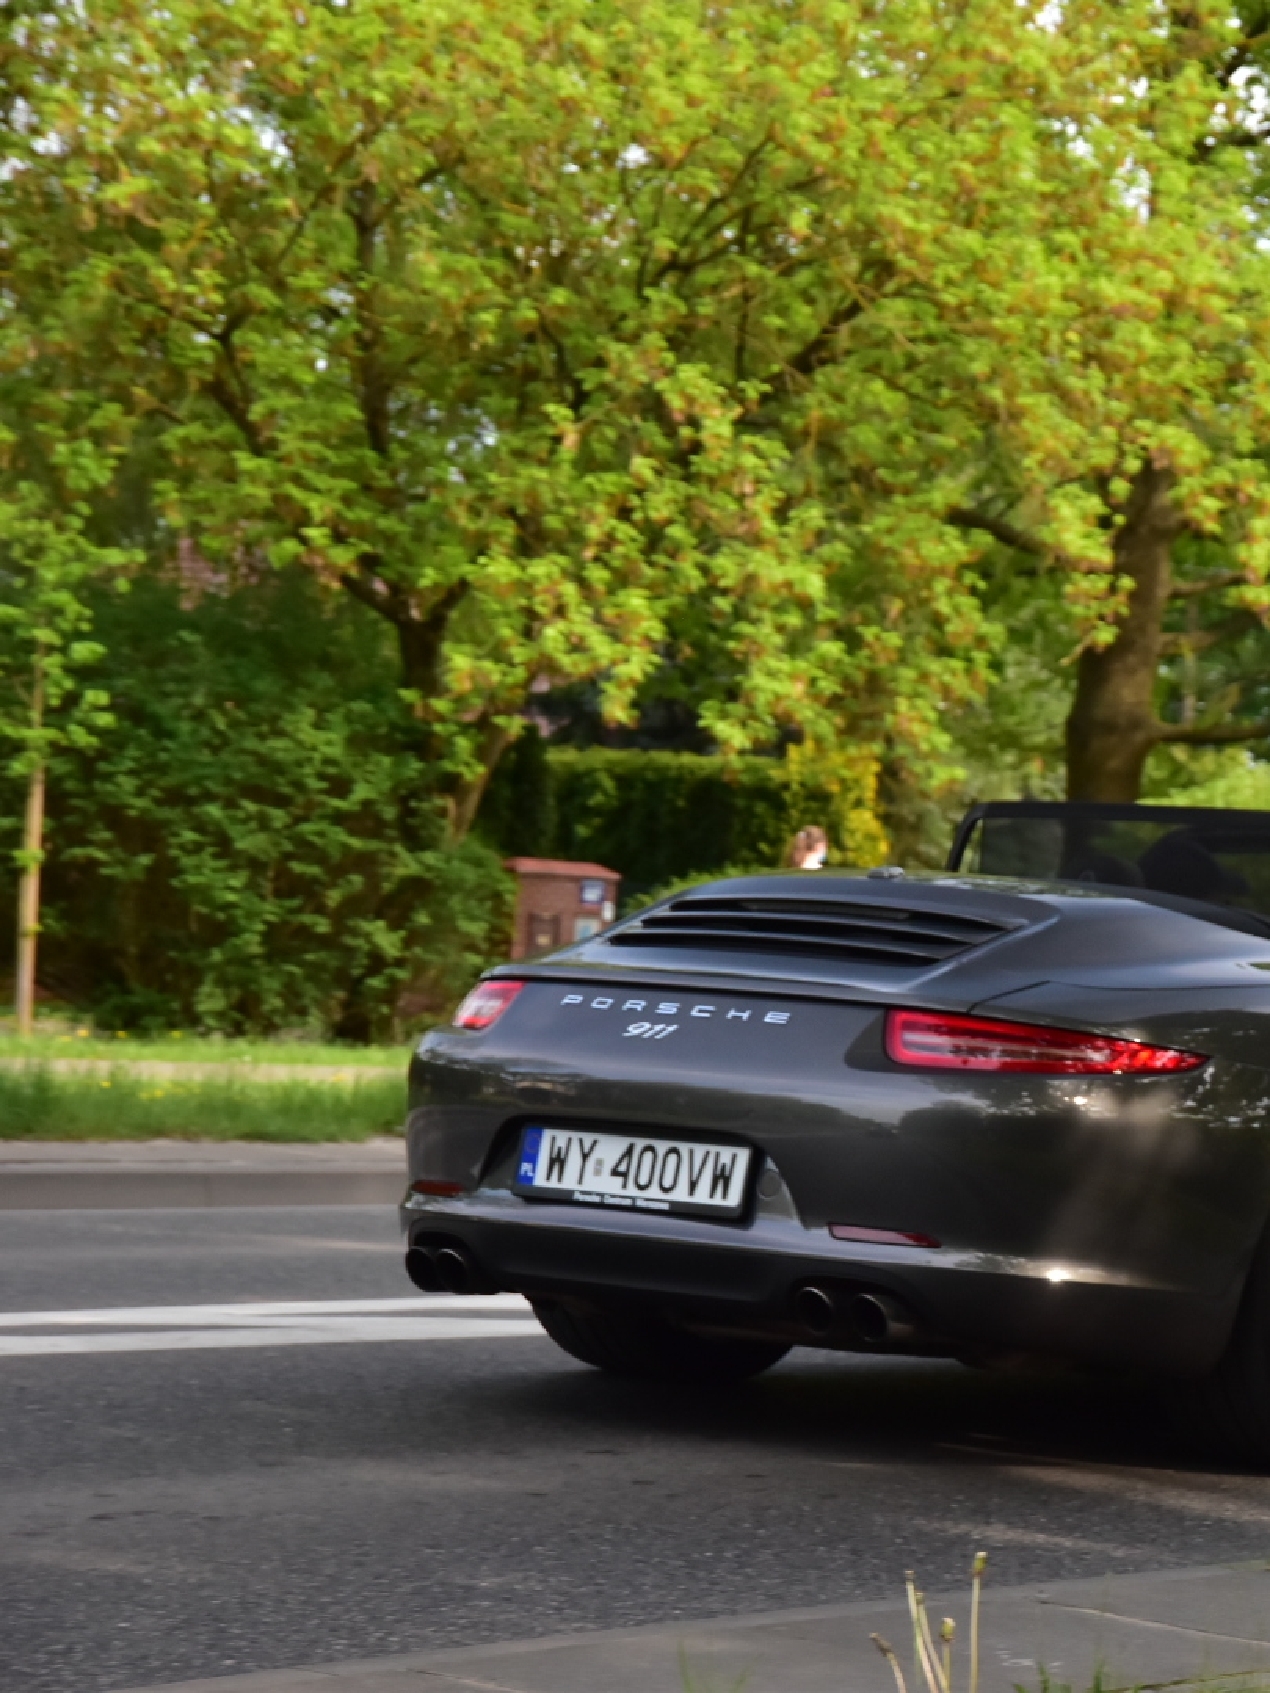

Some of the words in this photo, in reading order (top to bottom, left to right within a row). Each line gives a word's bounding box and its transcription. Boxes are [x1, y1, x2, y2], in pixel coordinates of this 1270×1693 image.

[560, 994, 791, 1025] PORSCHE
[622, 1021, 680, 1039] 911
[545, 1135, 598, 1185] WY
[610, 1142, 738, 1200] 400VW
